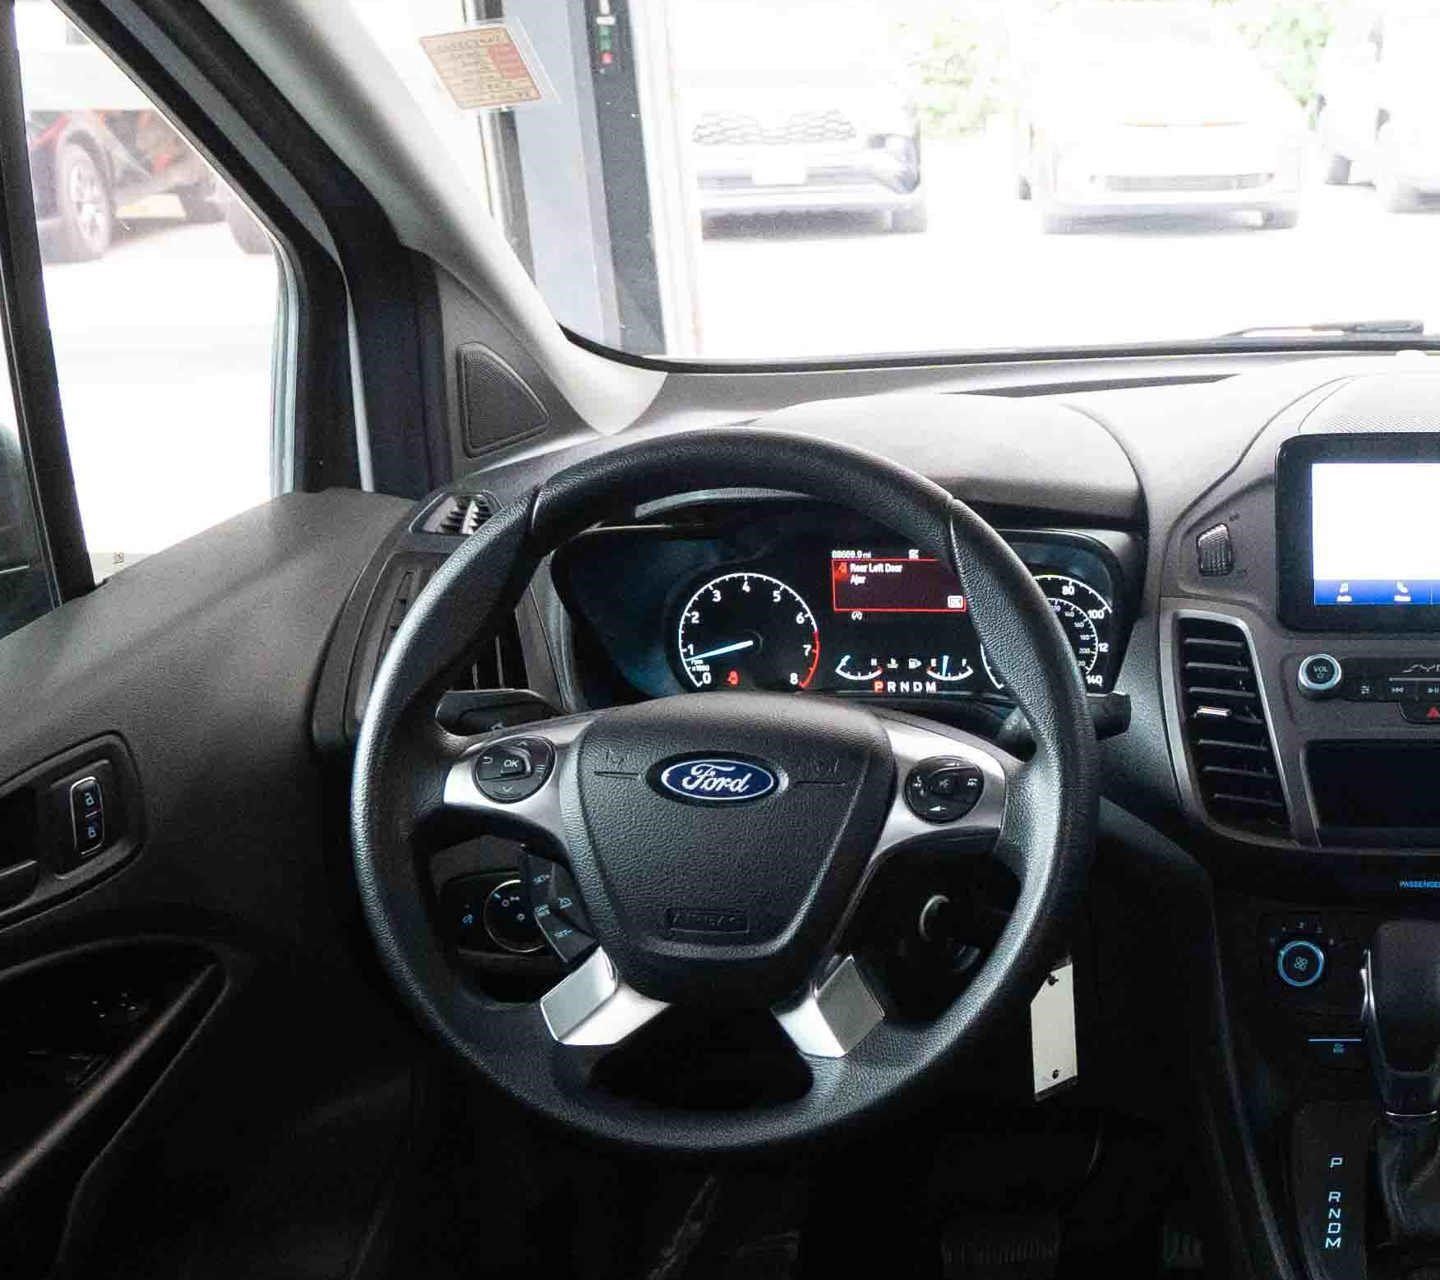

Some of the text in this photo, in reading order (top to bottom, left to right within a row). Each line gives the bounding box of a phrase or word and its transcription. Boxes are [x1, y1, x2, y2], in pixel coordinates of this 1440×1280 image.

[849, 563, 903, 573] Rear Left Door
[742, 580, 752, 592] 4
[849, 574, 866, 586] Ajar
[711, 589, 722, 602] 3
[772, 589, 782, 602] 5
[1062, 586, 1075, 595] 80
[690, 611, 700, 624] 2
[795, 611, 805, 624] 6
[1087, 609, 1105, 619] 100
[687, 643, 694, 656] 1
[802, 644, 812, 656] 7
[1098, 642, 1109, 652] 12
[1313, 665, 1329, 674] VOL
[702, 671, 712, 685] 0
[790, 672, 799, 685] 8
[1086, 675, 1103, 687] 140
[874, 681, 937, 693] P R N D M
[503, 759, 519, 768] OK
[681, 763, 752, 793] Ford
[1330, 1157, 1343, 1168] P
[1328, 1191, 1341, 1203] R
[1328, 1208, 1341, 1219] N
[1327, 1222, 1341, 1234] D
[1325, 1237, 1341, 1249] M
